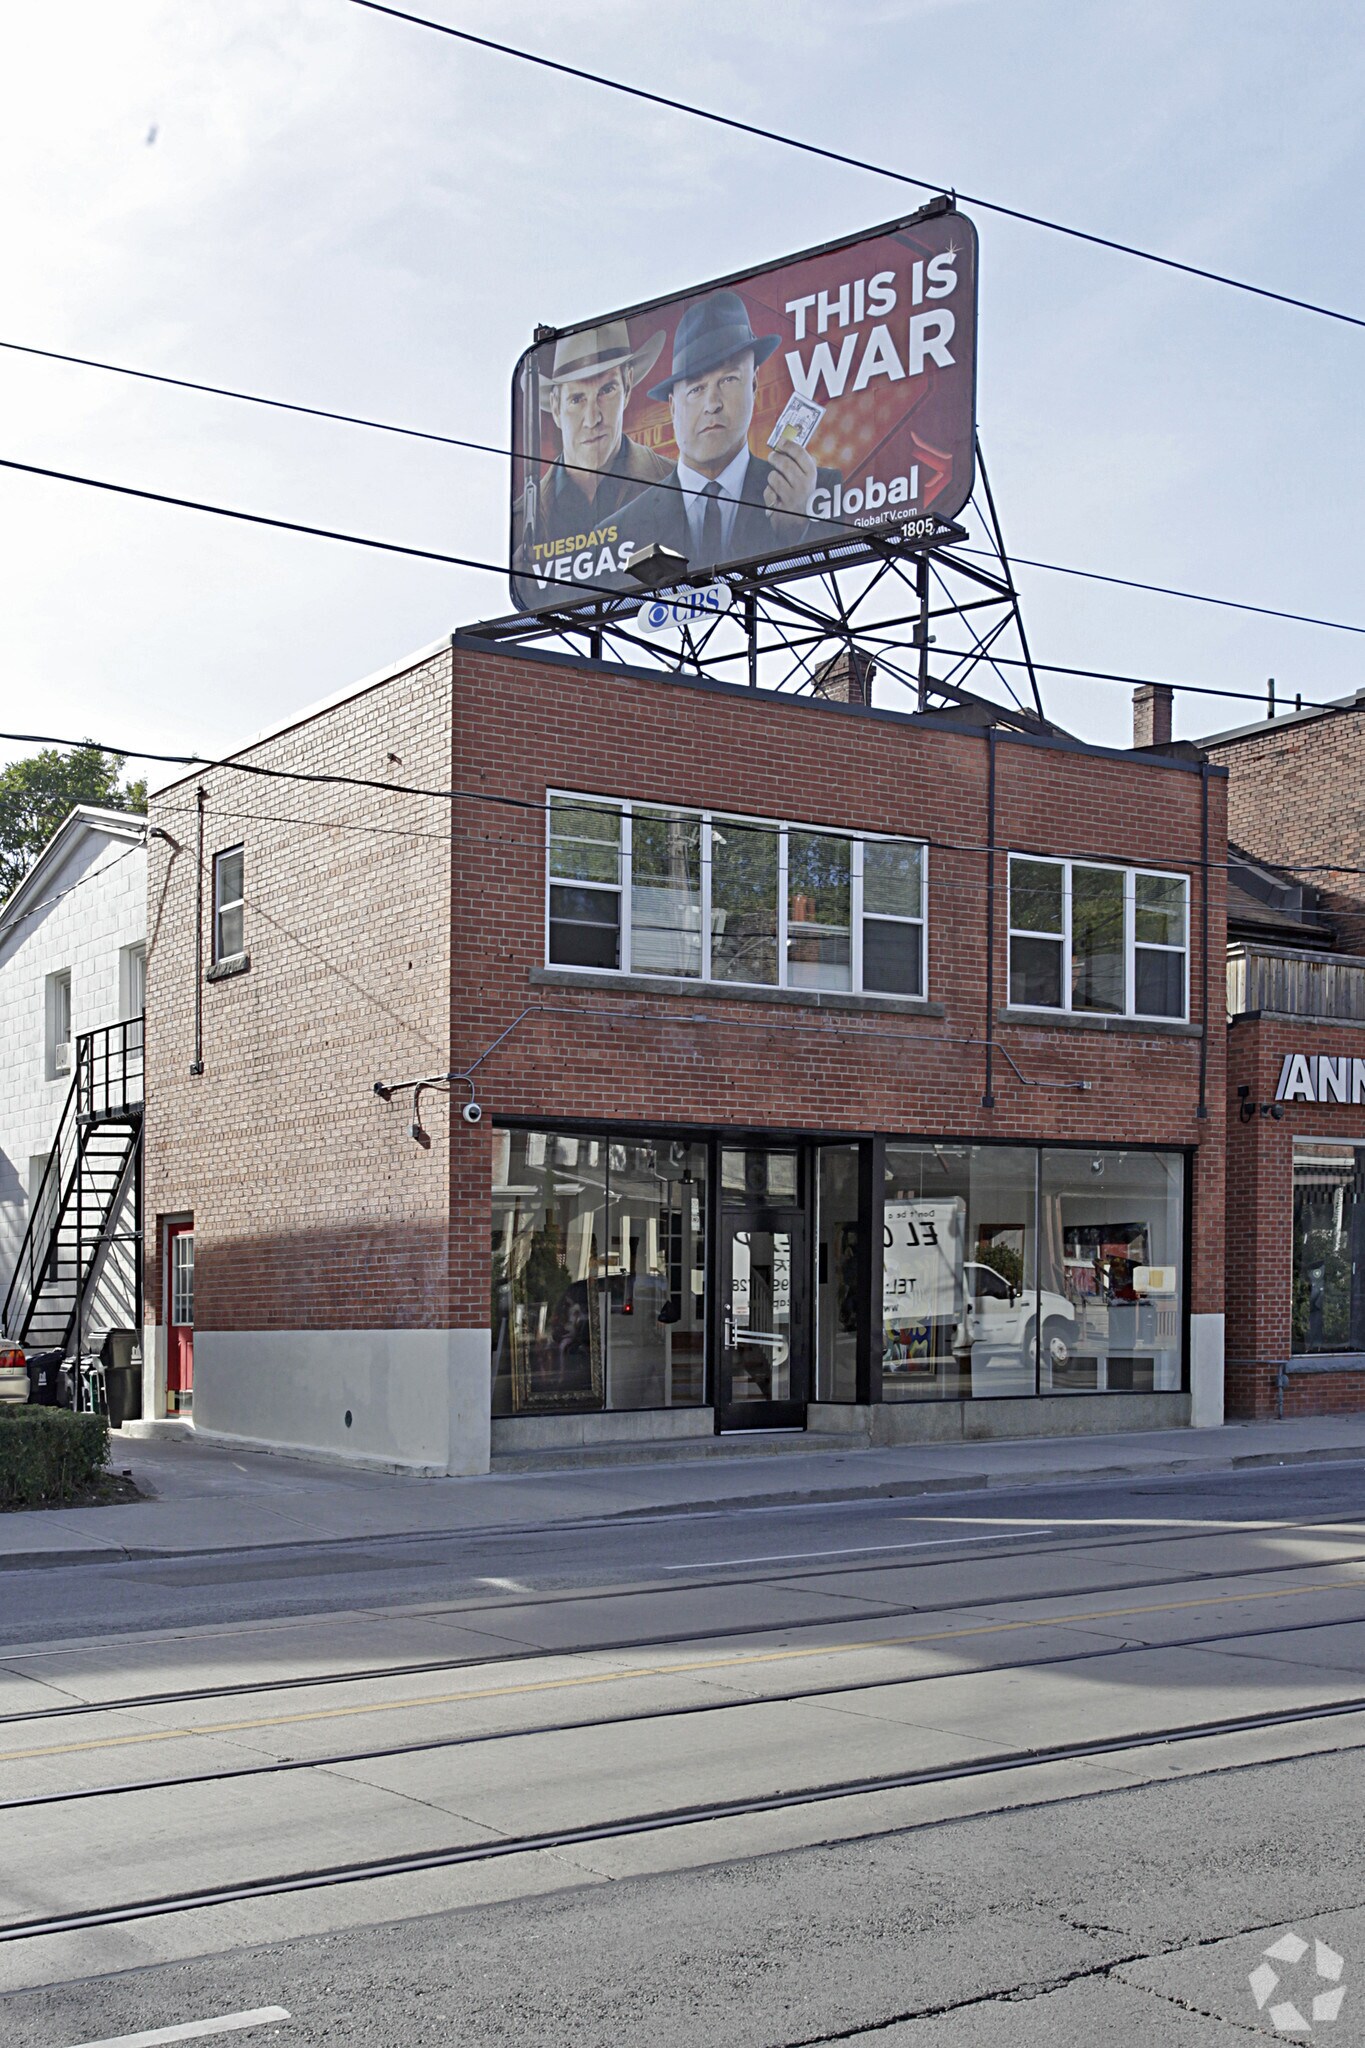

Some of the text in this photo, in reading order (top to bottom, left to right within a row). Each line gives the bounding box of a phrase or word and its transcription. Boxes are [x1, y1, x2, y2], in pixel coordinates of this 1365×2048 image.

[785, 252, 958, 341] THIS IS
[784, 308, 957, 399] WAR
[806, 464, 919, 522] Global
[854, 507, 918, 528] GlobalTV.com
[901, 517, 934, 537] 1805
[533, 525, 618, 560] TUESDAYS
[532, 541, 635, 590] VEGAS
[672, 588, 720, 623] CBS
